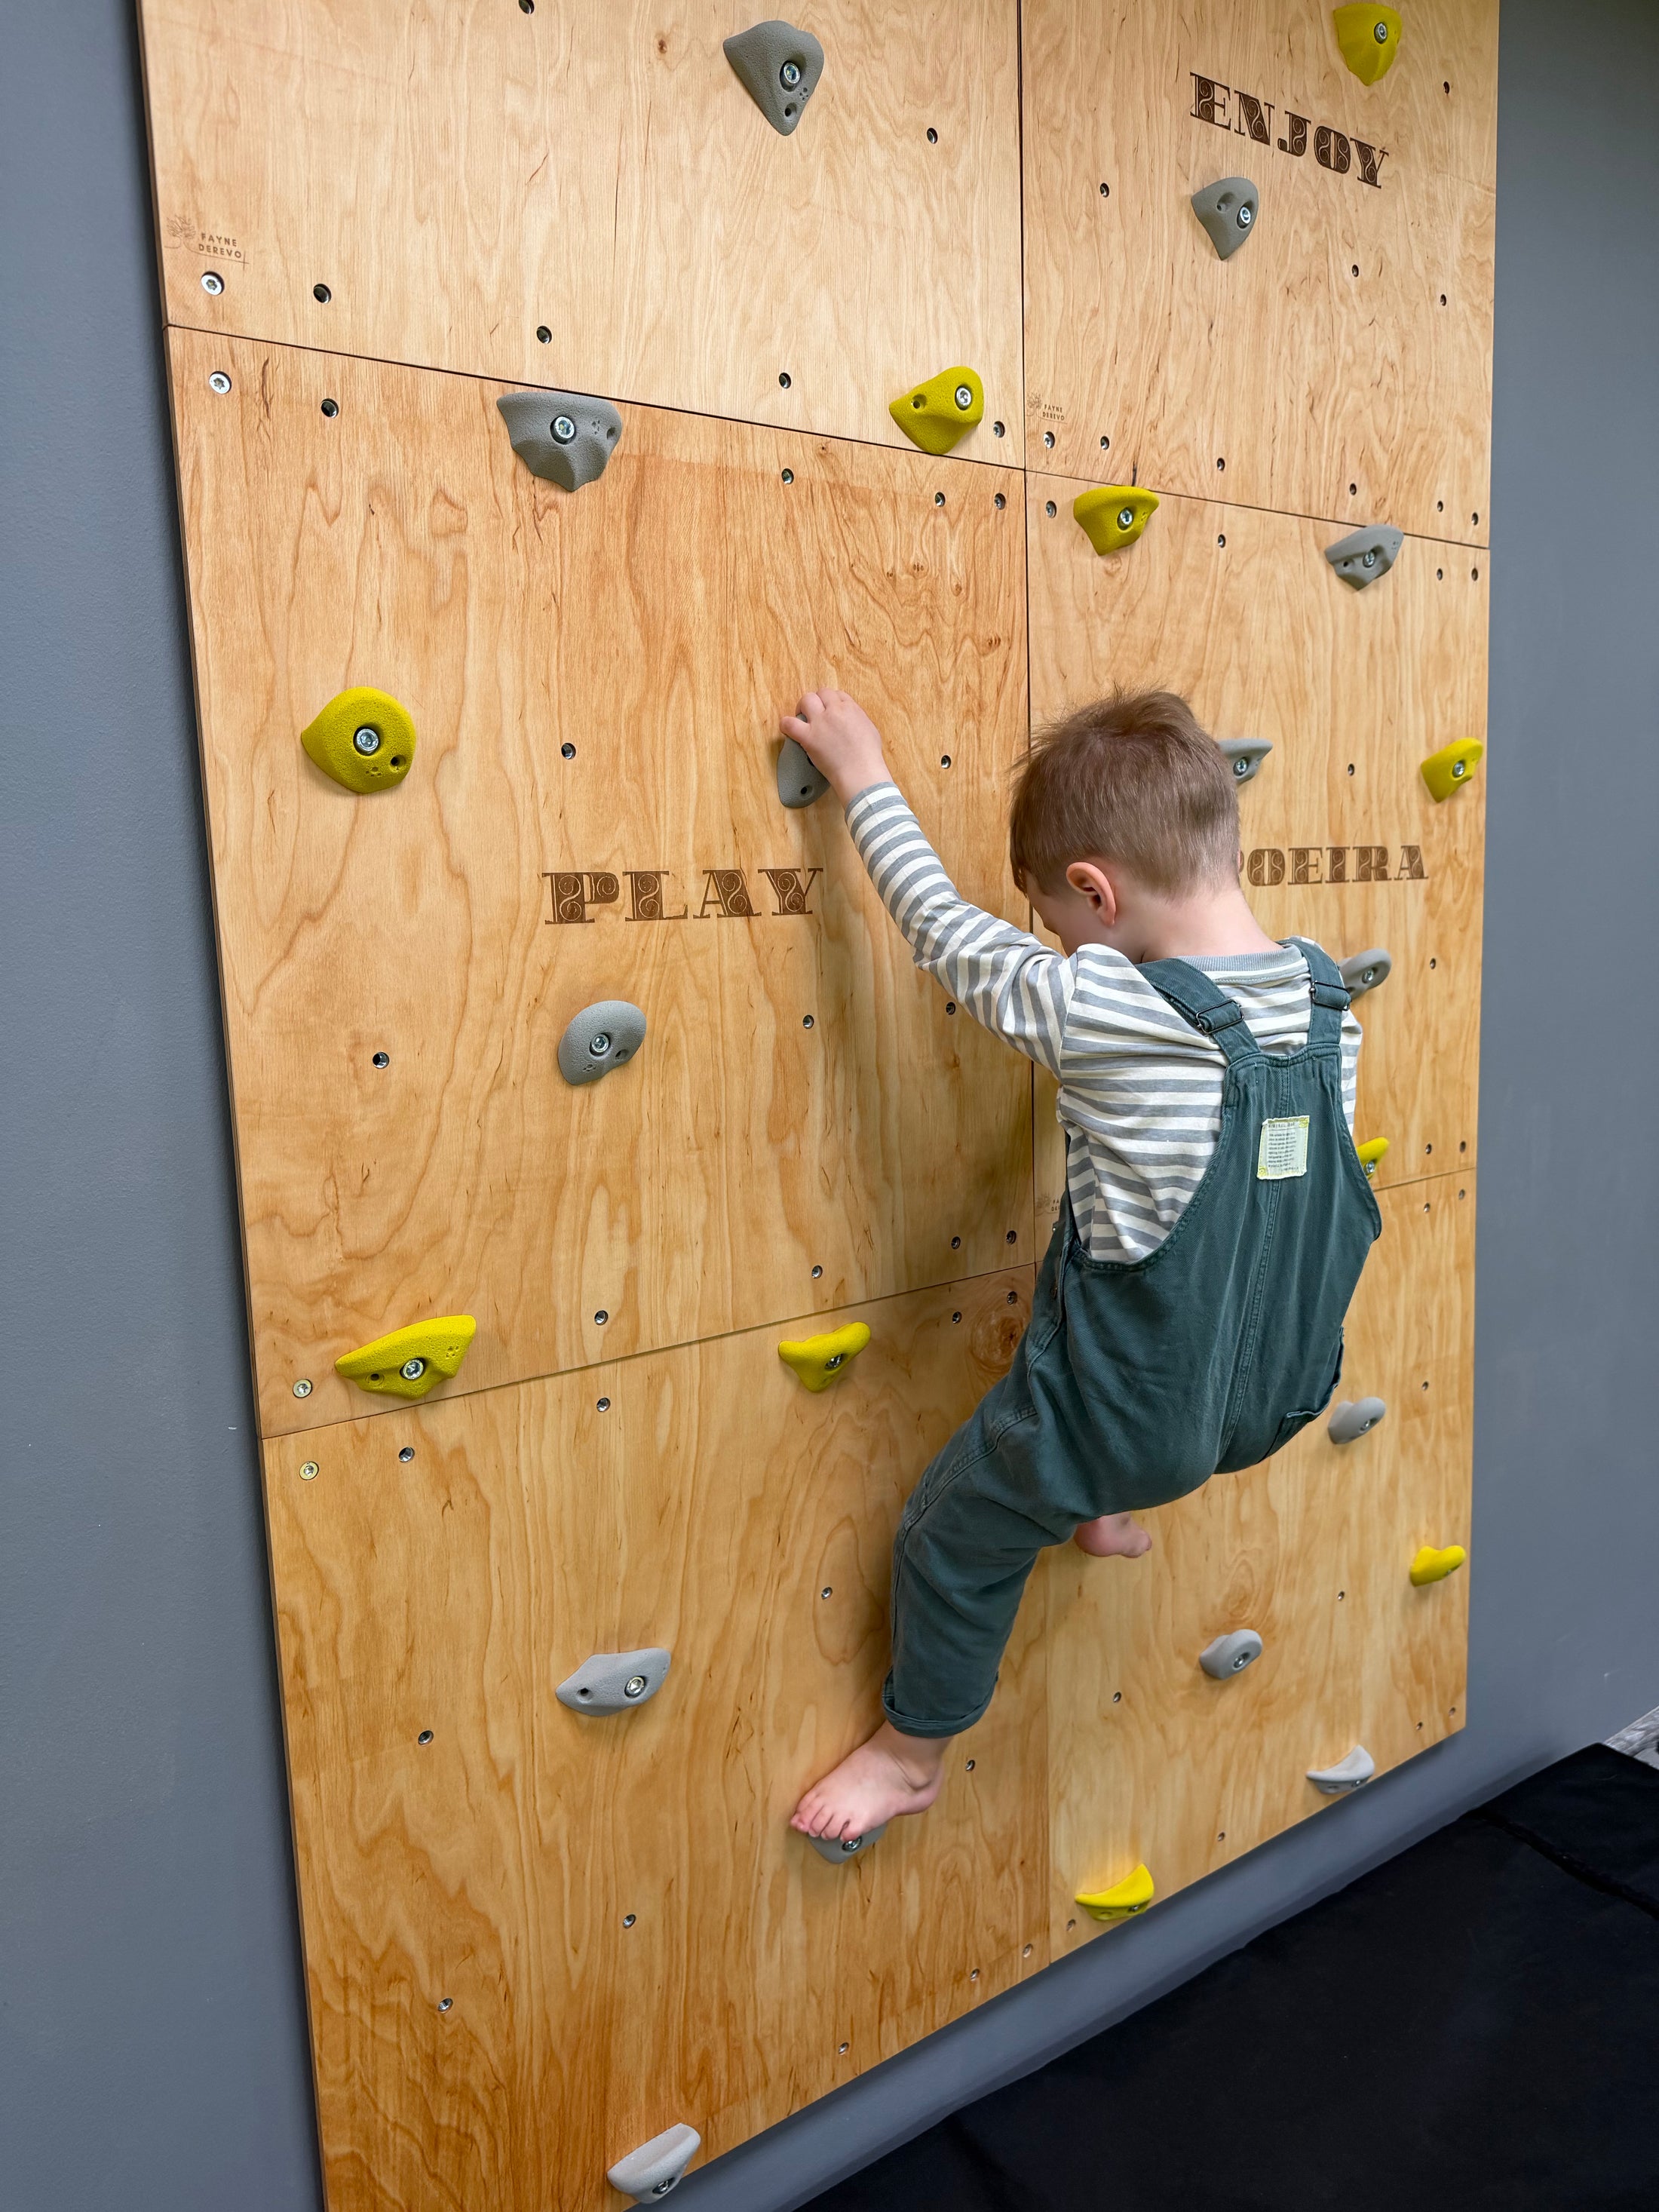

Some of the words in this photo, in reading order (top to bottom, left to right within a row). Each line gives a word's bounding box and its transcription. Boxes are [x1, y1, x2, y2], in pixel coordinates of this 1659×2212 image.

[1189, 71, 1389, 189] ENJOY
[198, 243, 242, 259] DEREVO
[201, 232, 238, 247] FAYNE
[1042, 411, 1065, 421] DEREVO
[1239, 845, 1429, 887] OEIRA
[541, 867, 823, 925] PLAY
